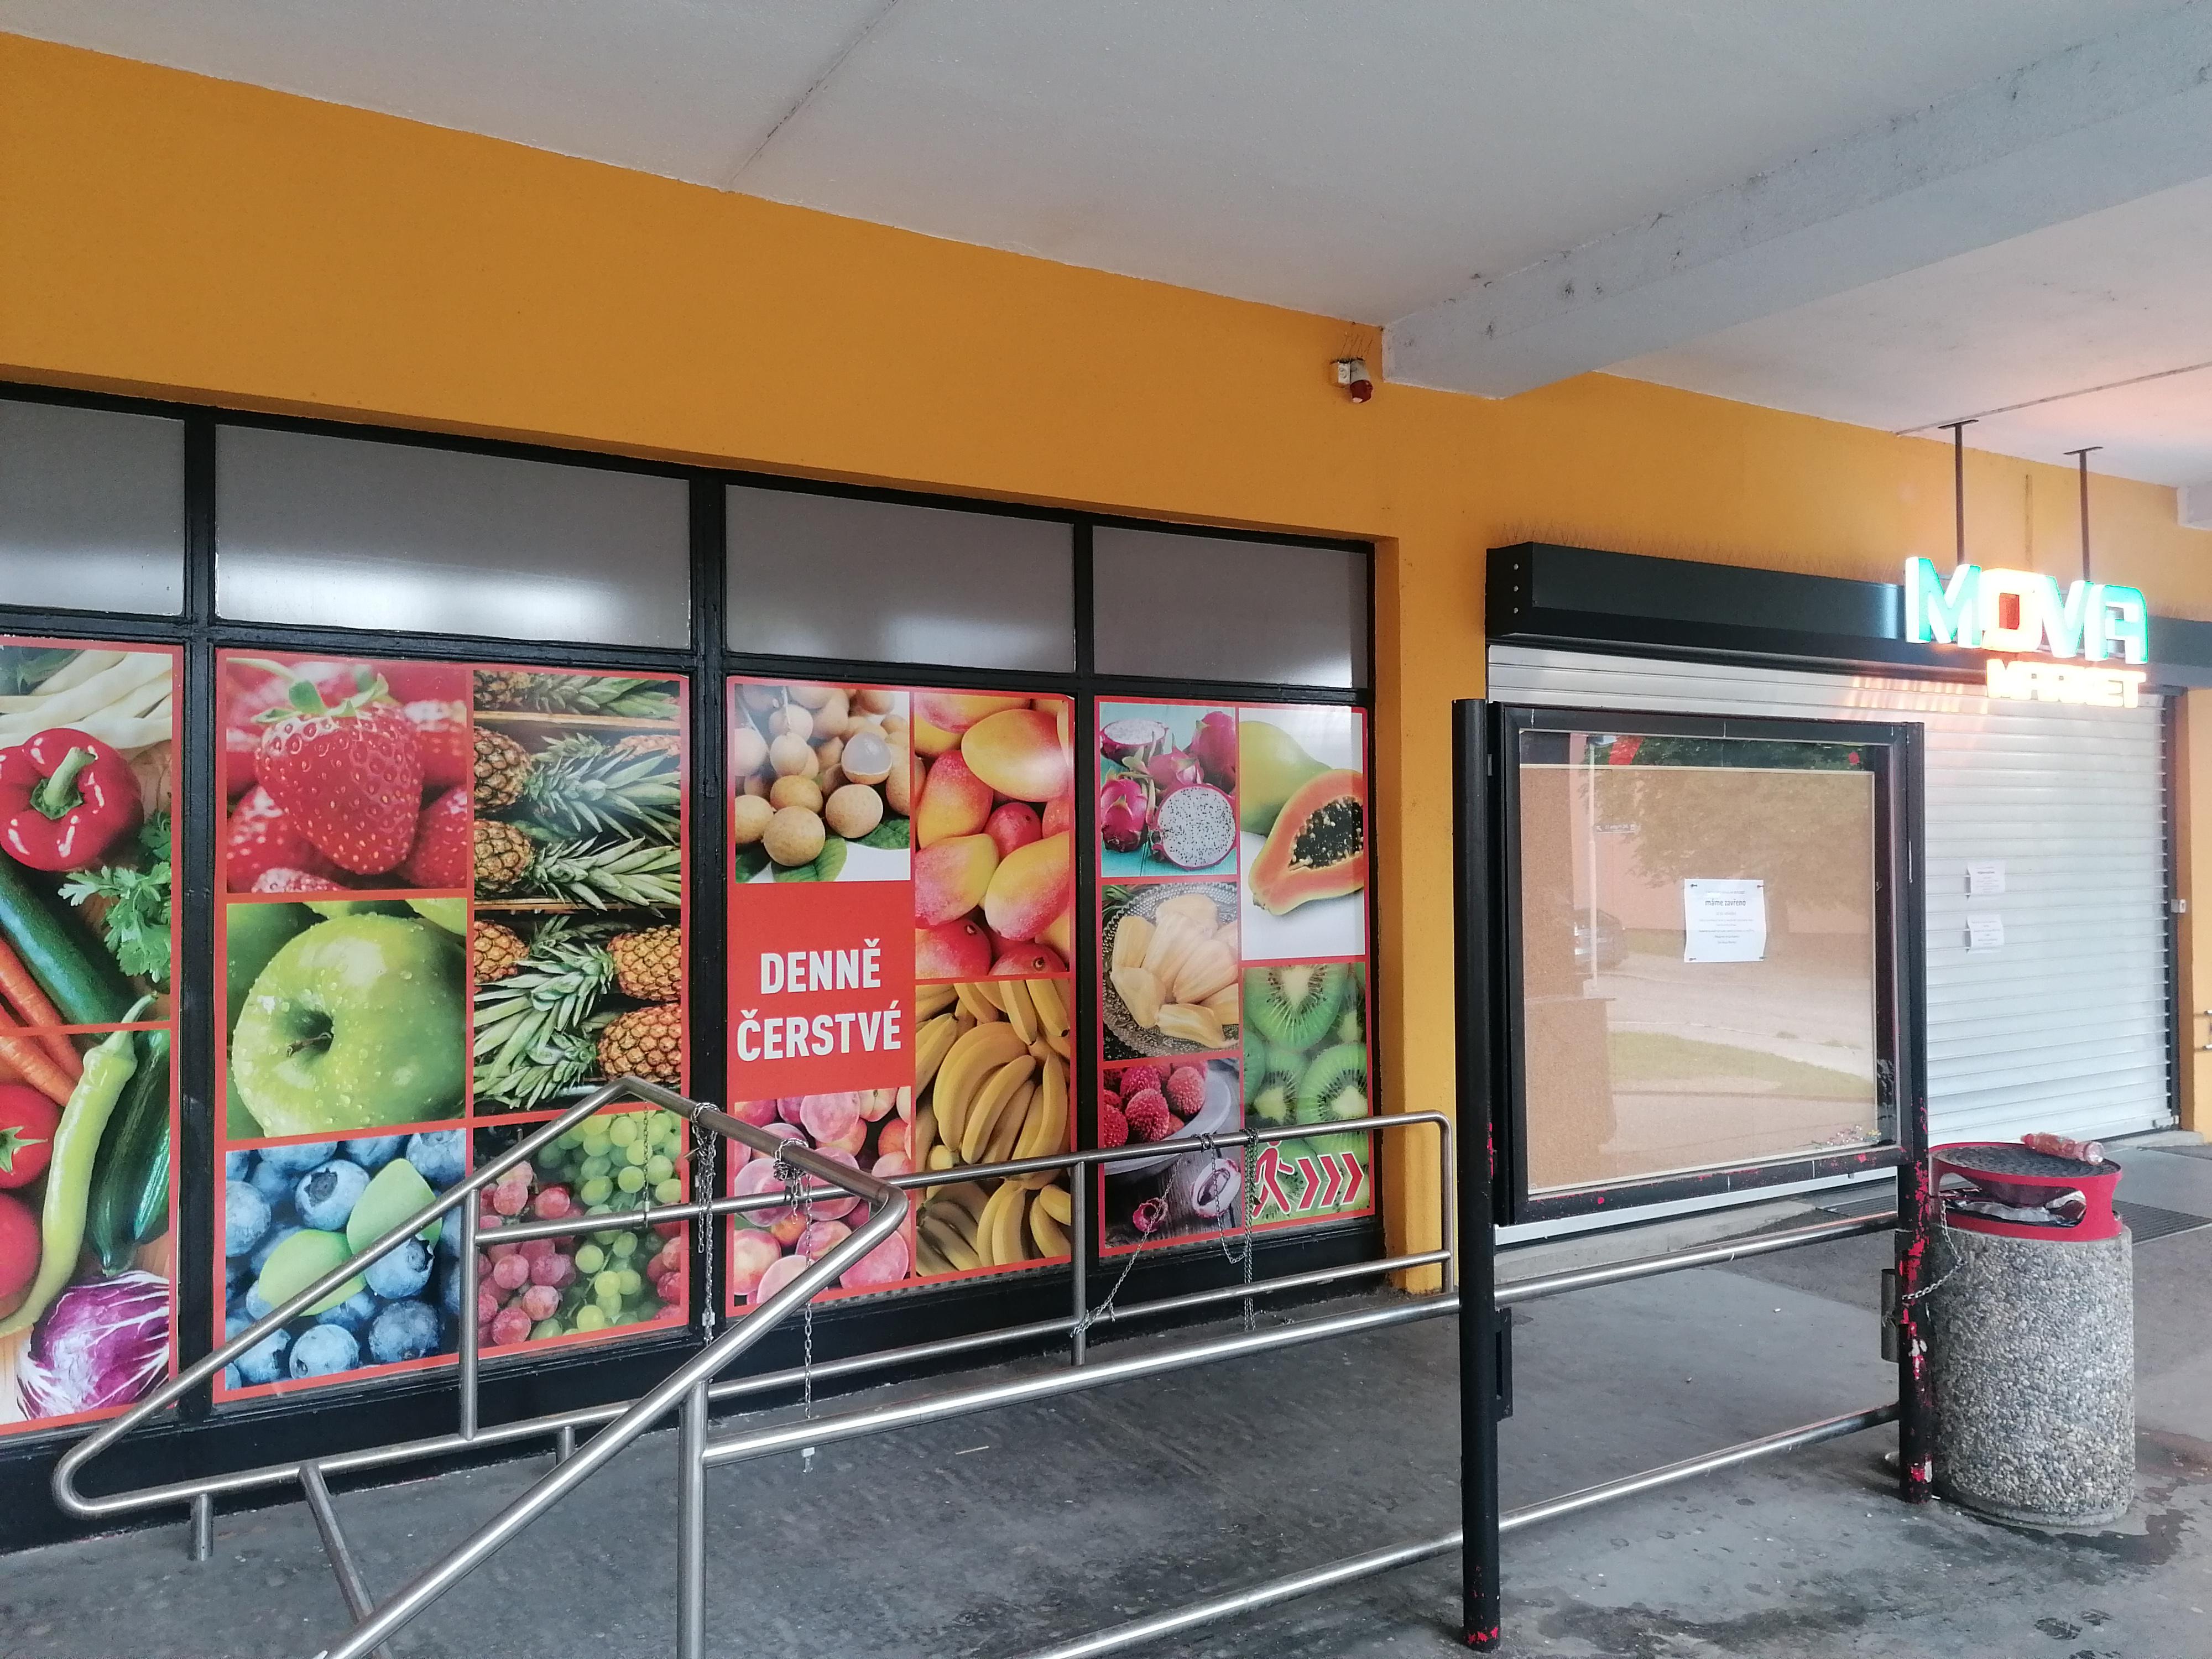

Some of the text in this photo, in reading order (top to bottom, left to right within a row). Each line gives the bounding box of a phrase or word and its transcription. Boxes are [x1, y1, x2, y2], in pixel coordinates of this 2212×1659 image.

[1905, 556, 2148, 664] MOVA
[1986, 659, 2146, 708] MARKET
[1705, 898, 1723, 906] máme
[760, 938, 881, 994] DENNĚ
[737, 1000, 901, 1062] ČERSTVÉ
